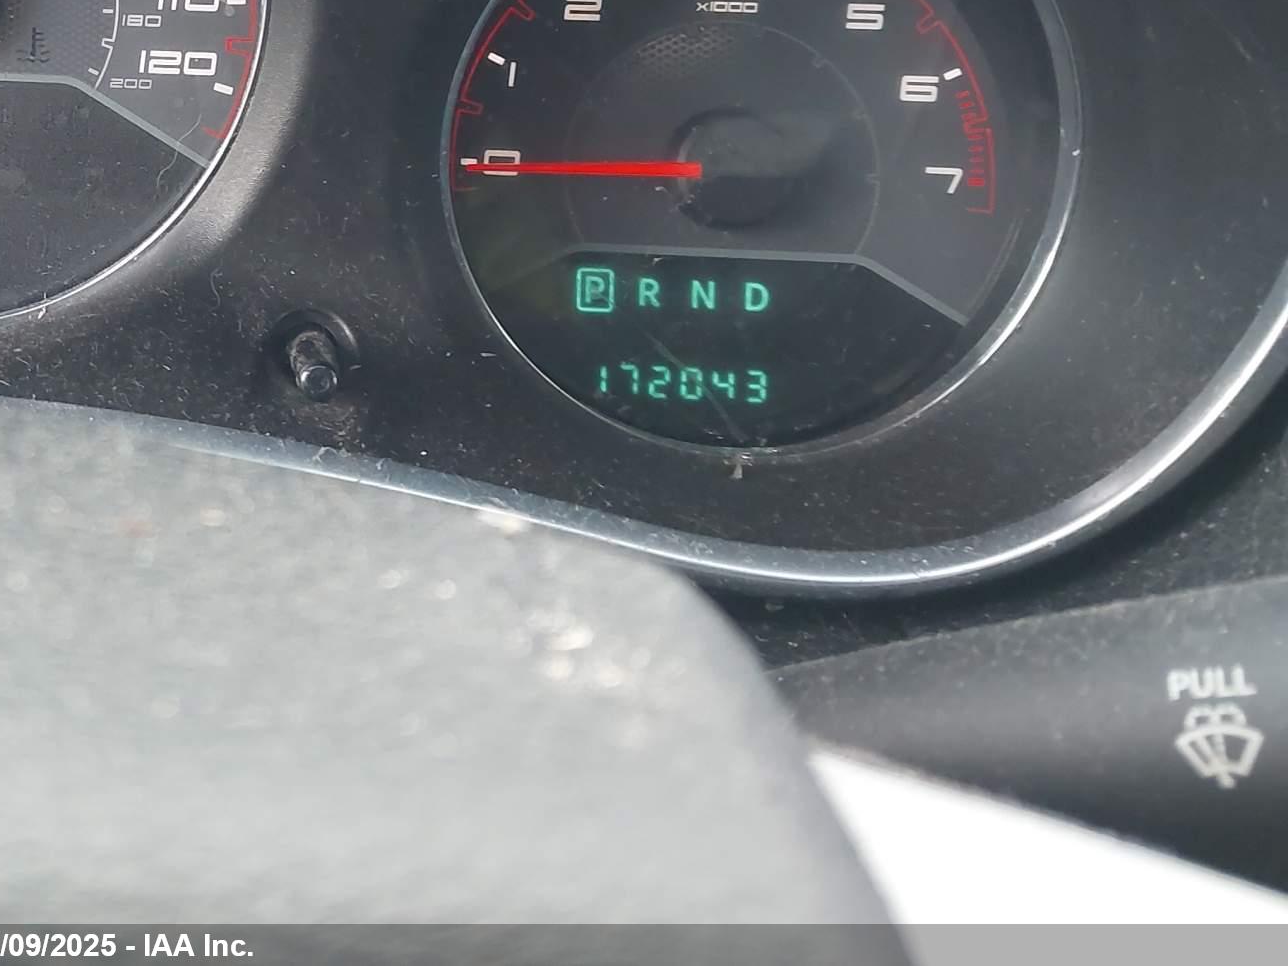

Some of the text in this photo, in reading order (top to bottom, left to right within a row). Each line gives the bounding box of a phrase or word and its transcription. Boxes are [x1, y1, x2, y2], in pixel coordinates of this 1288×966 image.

[696, 1, 758, 13] x1000
[846, 4, 885, 30] 5
[122, 14, 162, 27] 180
[139, 50, 217, 76] 120
[508, 62, 516, 87] 1
[110, 78, 152, 89] 200
[900, 76, 939, 102] 6
[483, 149, 520, 176] 0
[925, 167, 964, 193] 7
[584, 276, 770, 311] P R N D
[599, 364, 768, 403] 172043
[1167, 664, 1257, 701] PULL
